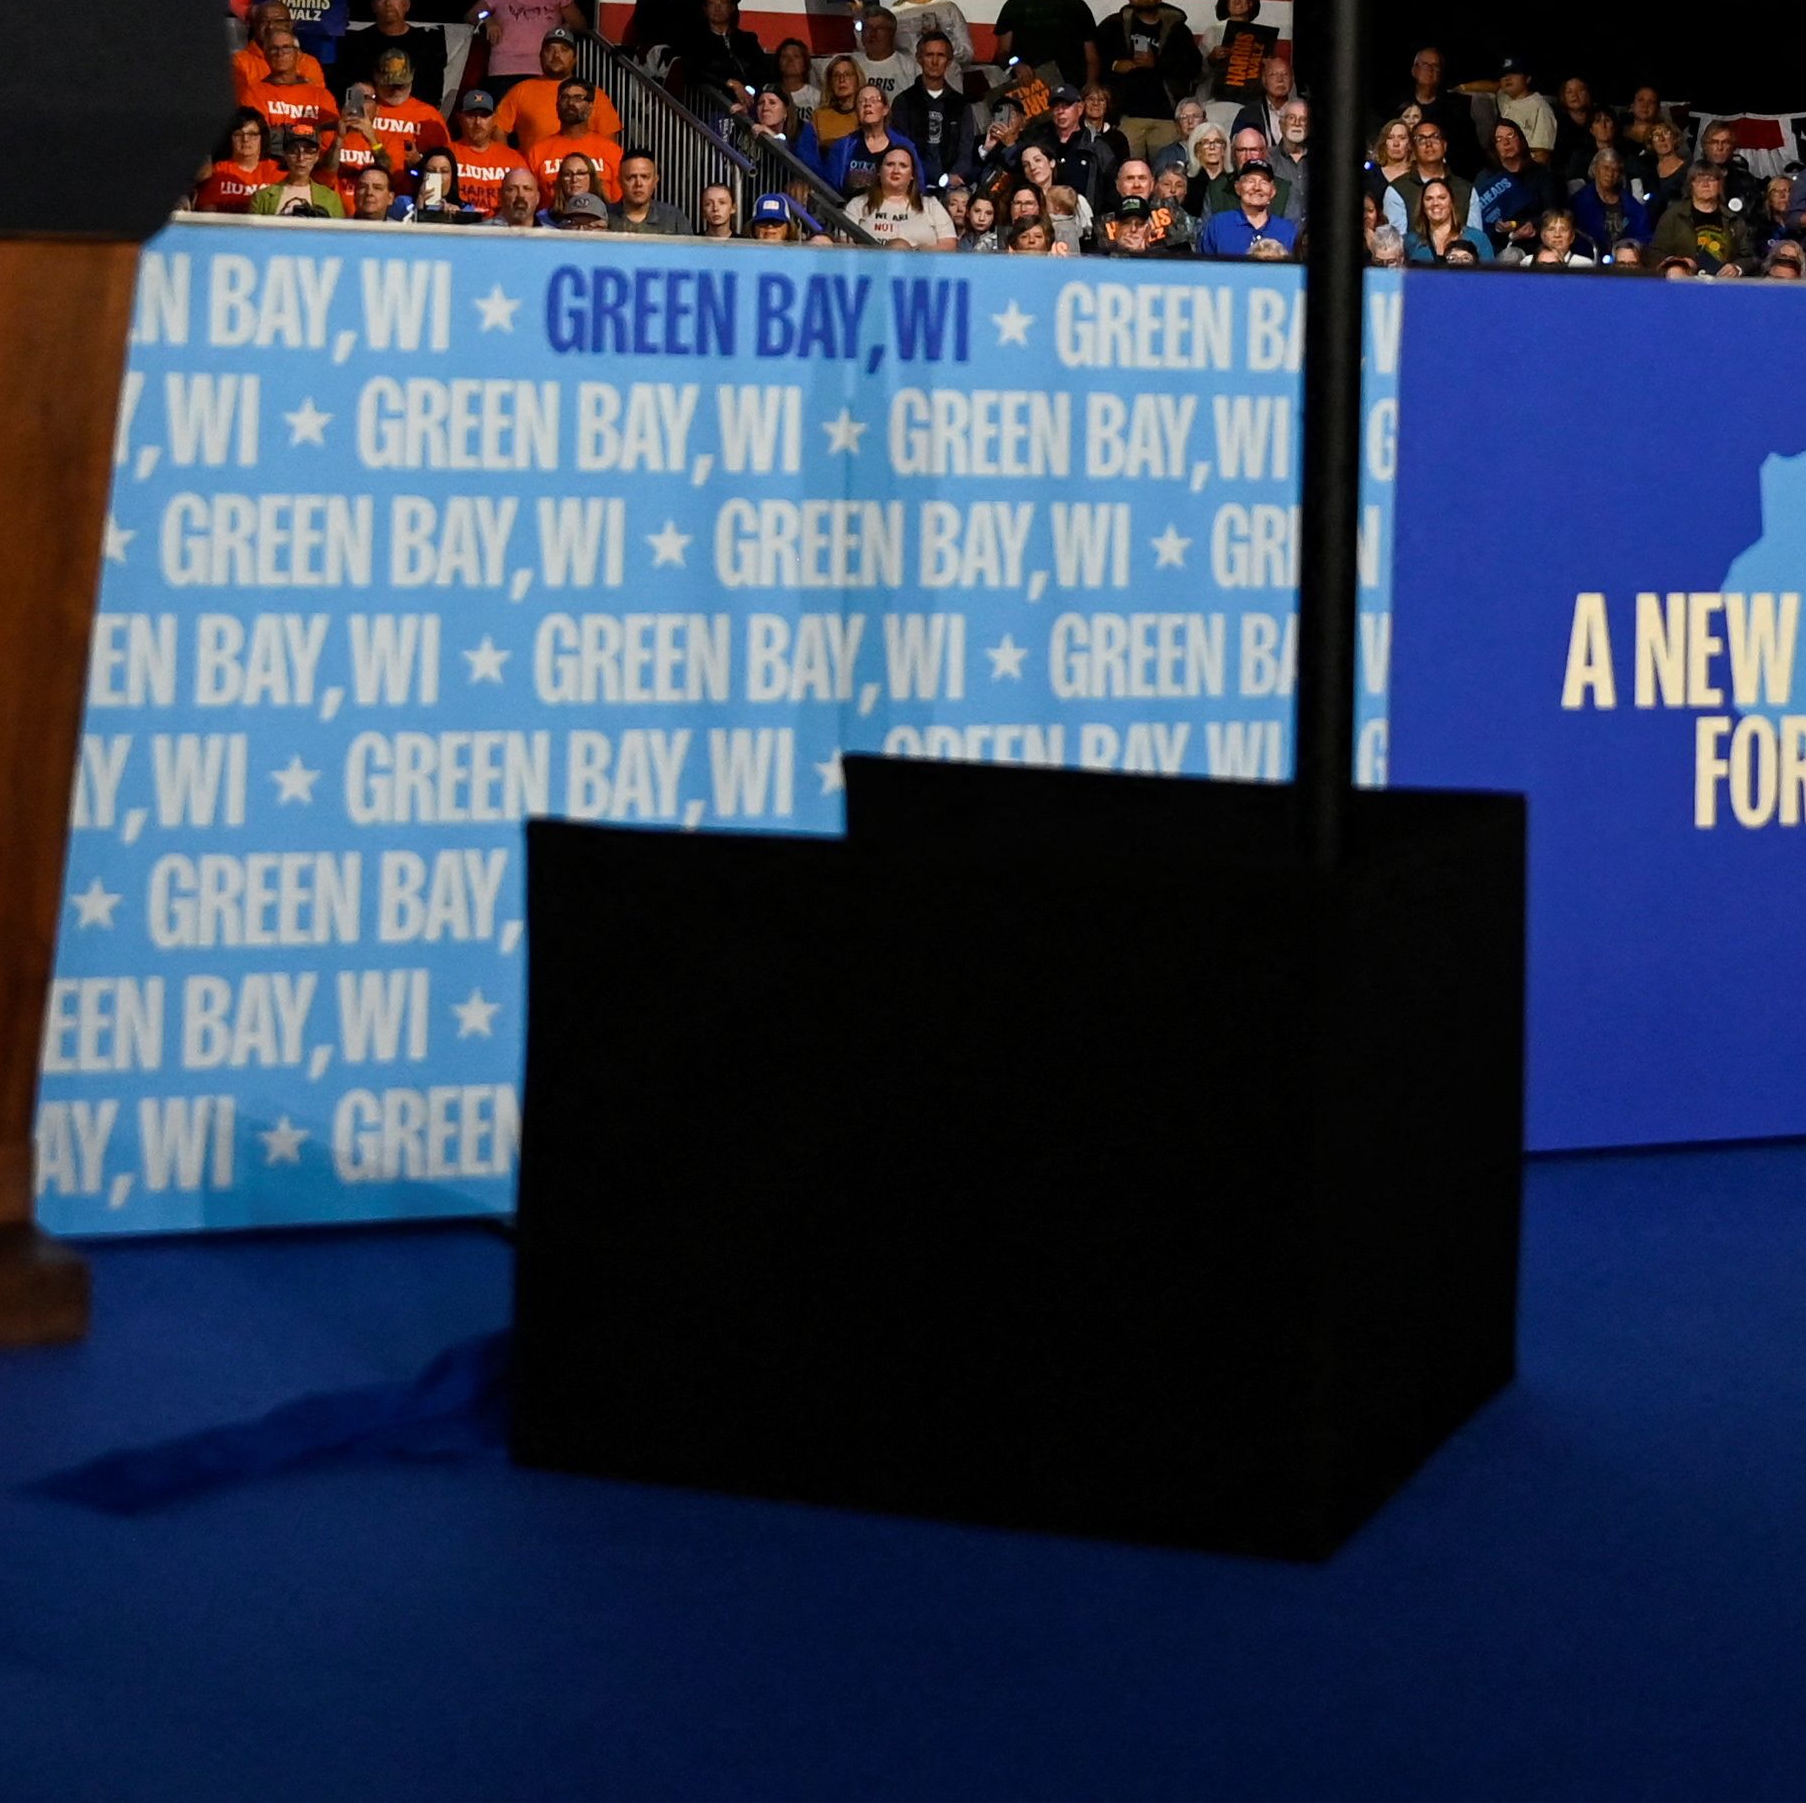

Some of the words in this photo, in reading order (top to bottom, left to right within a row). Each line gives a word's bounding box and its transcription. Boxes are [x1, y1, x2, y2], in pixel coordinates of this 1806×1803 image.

[544, 264, 737, 357] GREEN
[1054, 280, 1233, 371] GREEN
[357, 376, 559, 471] GREEN
[889, 387, 1070, 478] GREEN
[160, 492, 373, 588] GREEN
[714, 498, 904, 590] GREEN
[533, 612, 730, 705] GREEN
[1049, 612, 1225, 700] GREEN
[1561, 593, 1615, 710] A
[1634, 592, 1796, 708] NEW
[345, 730, 551, 827] GREEN
[148, 850, 362, 950] GREEN
